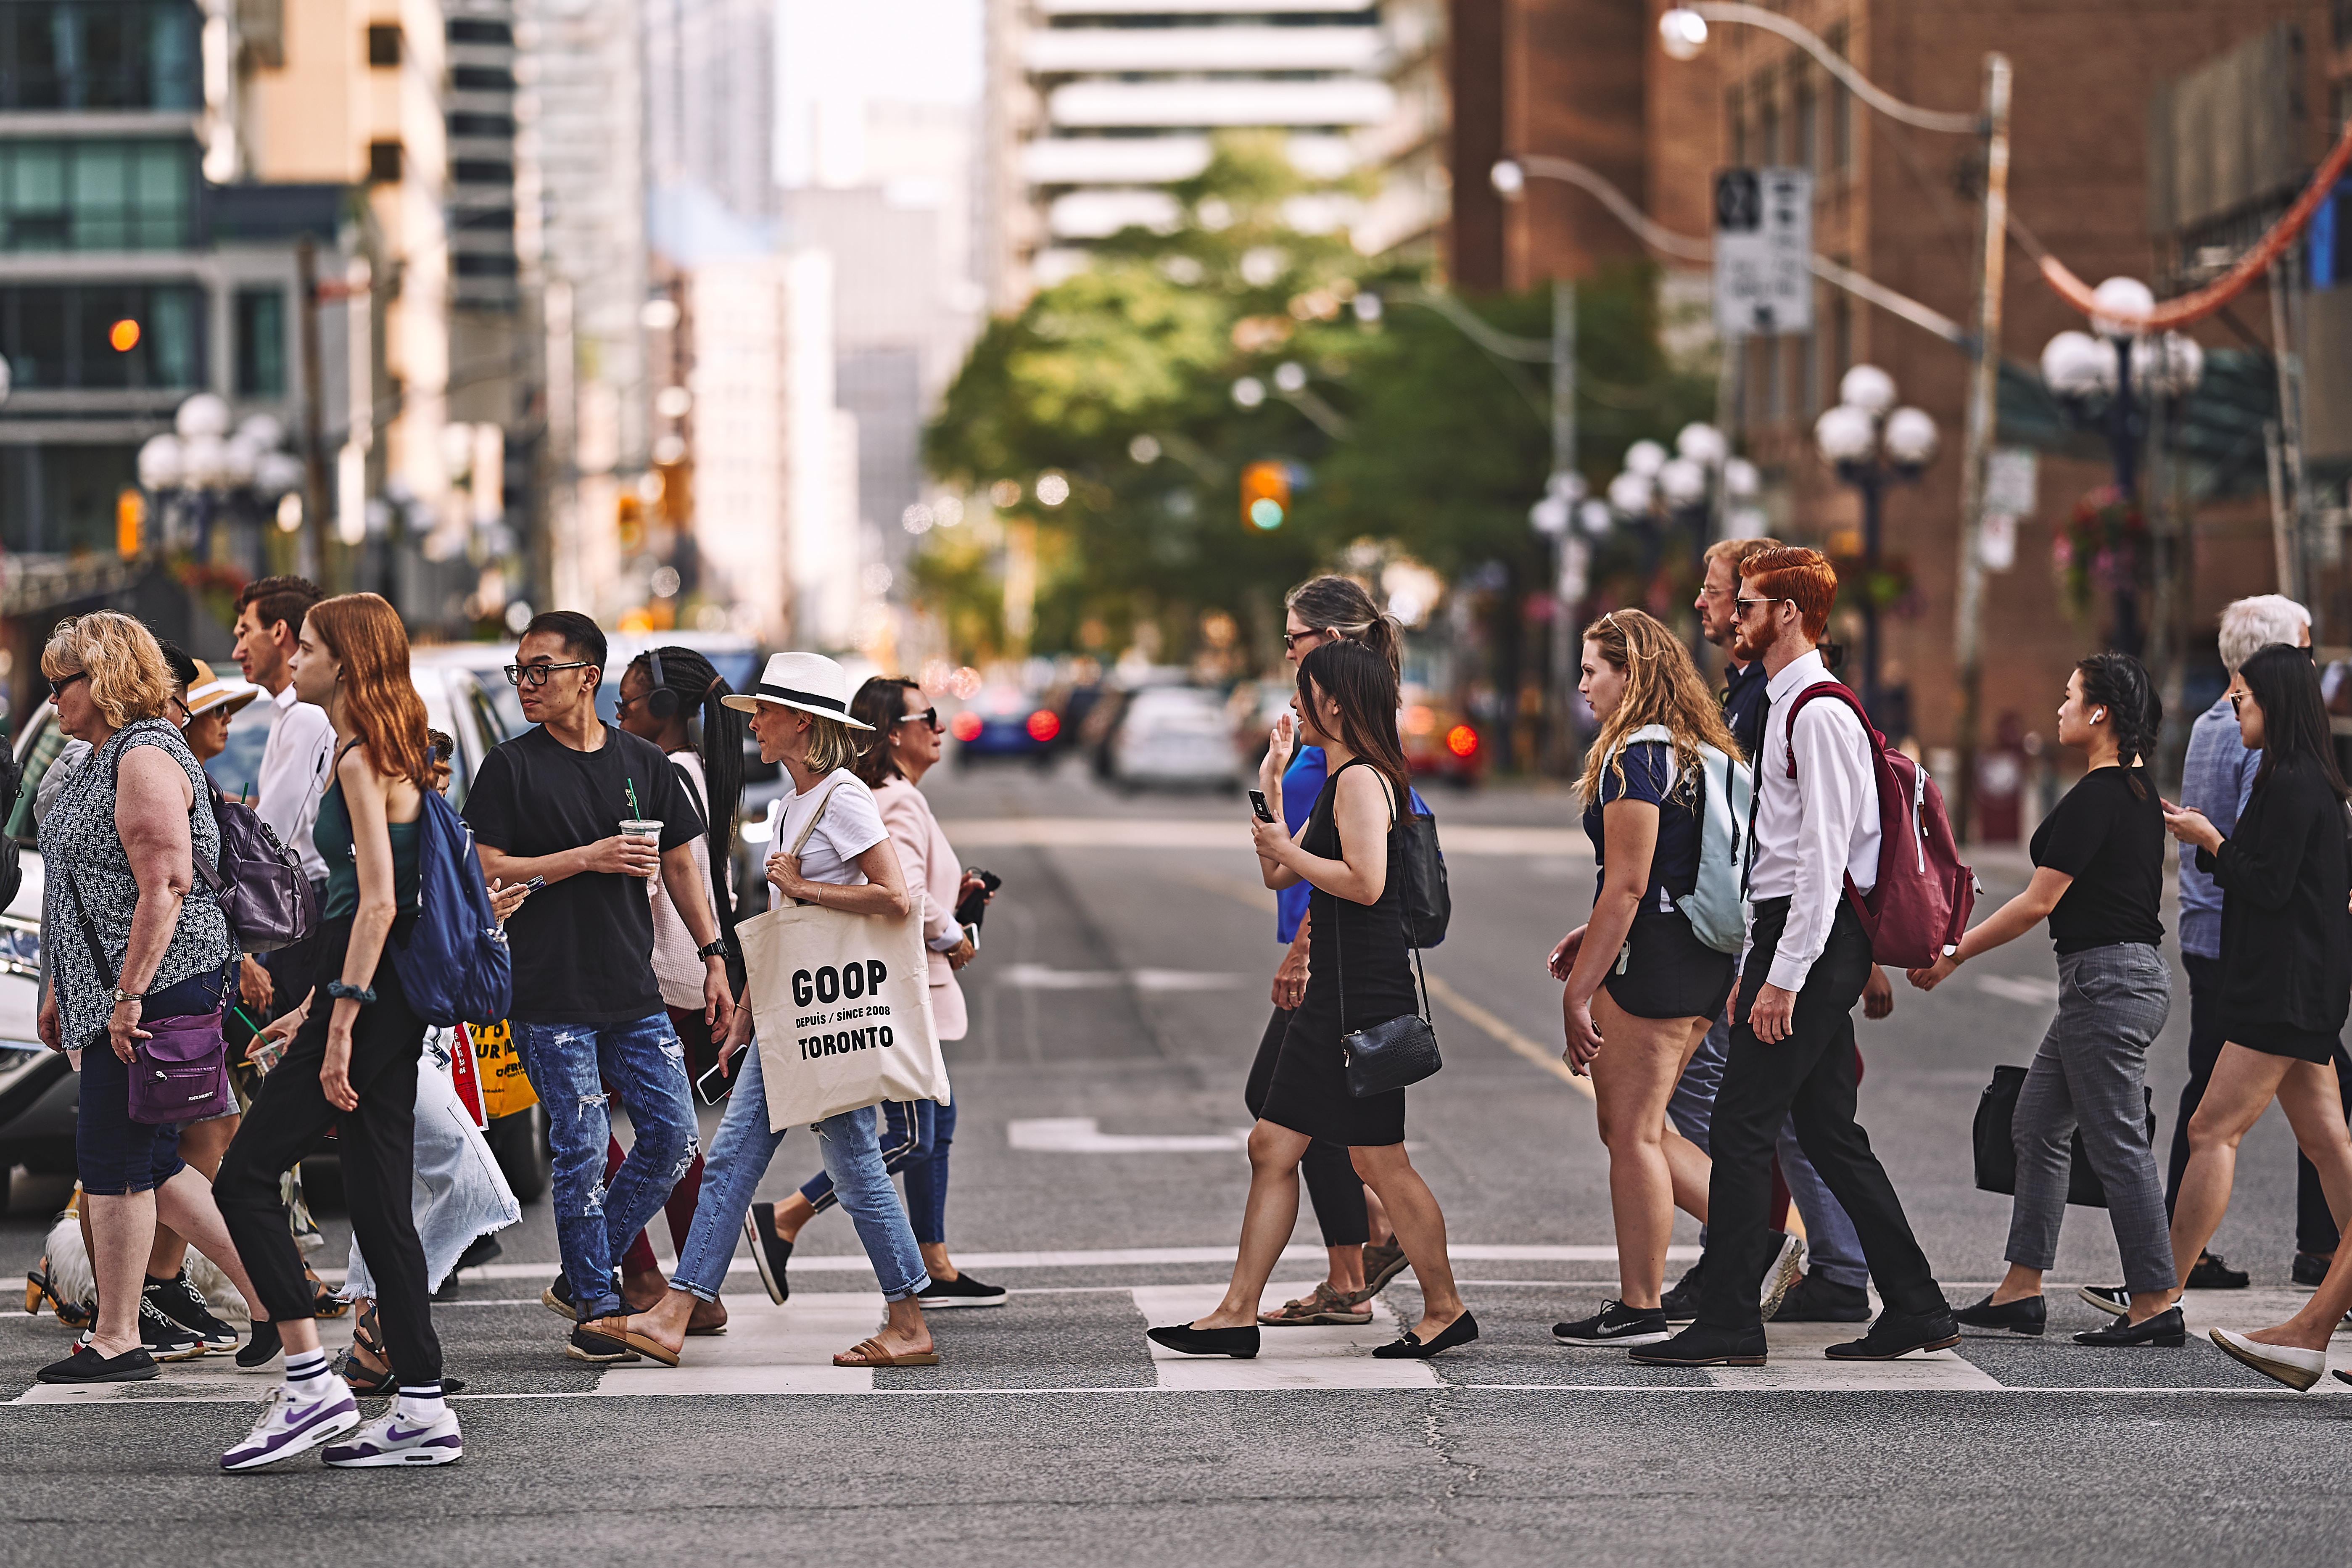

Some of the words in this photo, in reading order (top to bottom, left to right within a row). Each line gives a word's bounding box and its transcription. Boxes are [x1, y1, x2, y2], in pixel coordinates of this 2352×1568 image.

[792, 960, 887, 1007] GOOP
[866, 1006, 890, 1016] 2008
[798, 1026, 893, 1060] TORONTO
